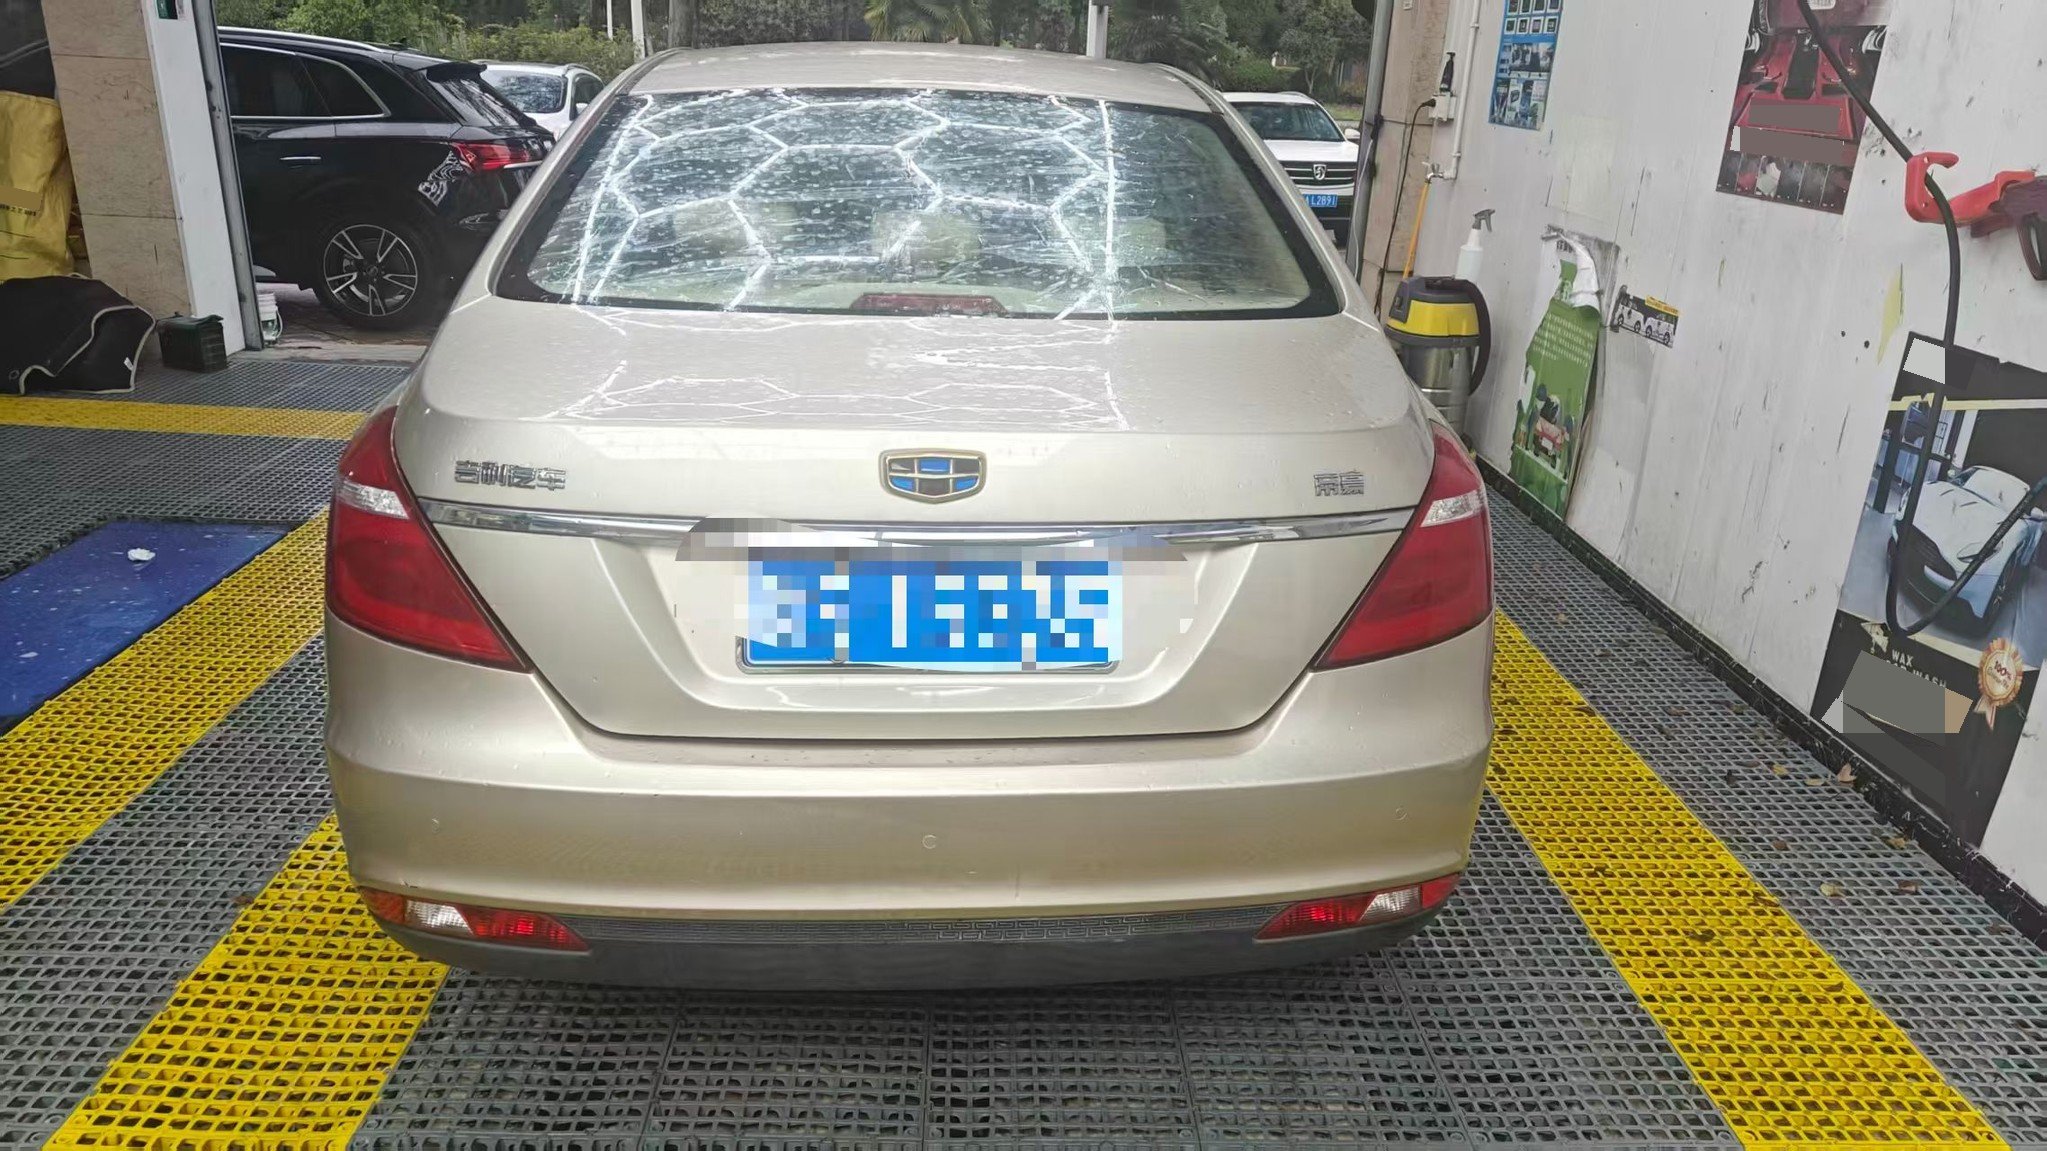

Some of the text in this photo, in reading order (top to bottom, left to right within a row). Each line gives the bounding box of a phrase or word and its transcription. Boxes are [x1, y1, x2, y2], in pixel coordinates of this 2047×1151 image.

[454, 460, 566, 491] 吉利汽车
[1892, 649, 1914, 667] WAX
